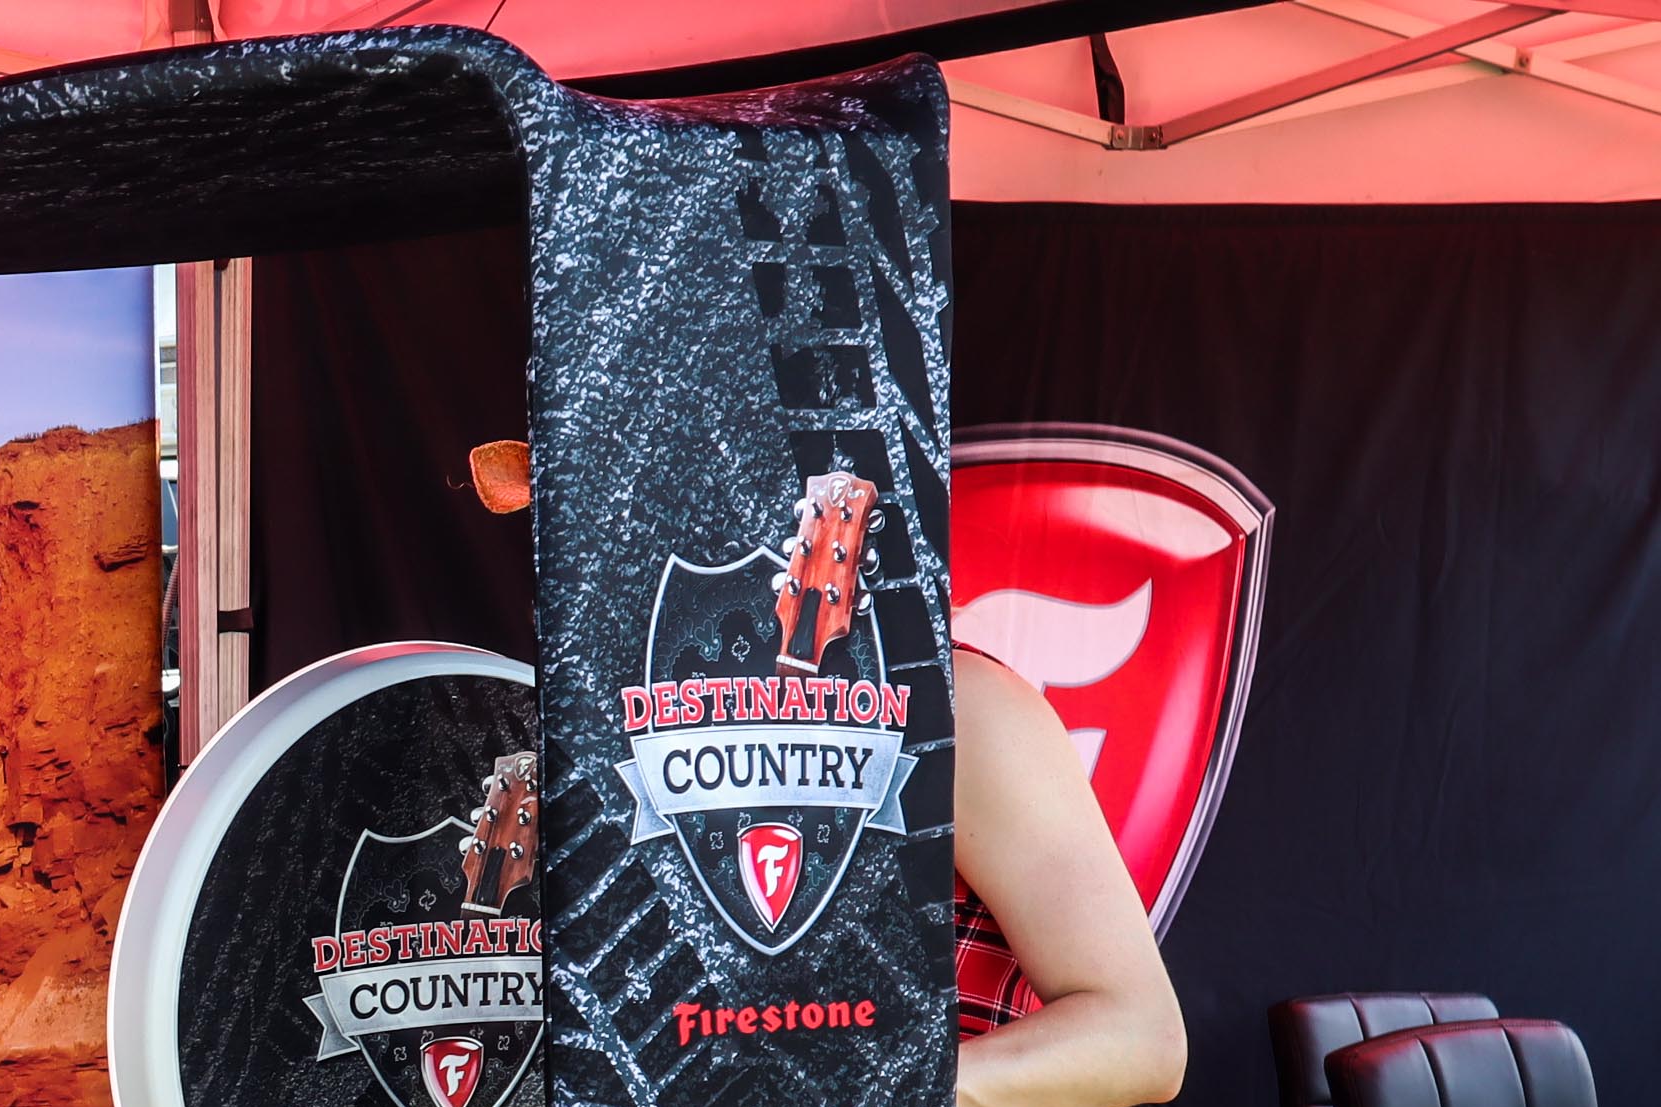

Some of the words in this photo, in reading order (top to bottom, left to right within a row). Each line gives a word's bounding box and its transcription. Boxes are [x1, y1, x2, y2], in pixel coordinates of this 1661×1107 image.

[621, 673, 911, 733] DESTINATION
[662, 743, 874, 795] COUNTRY
[673, 996, 876, 1047] Firestone
